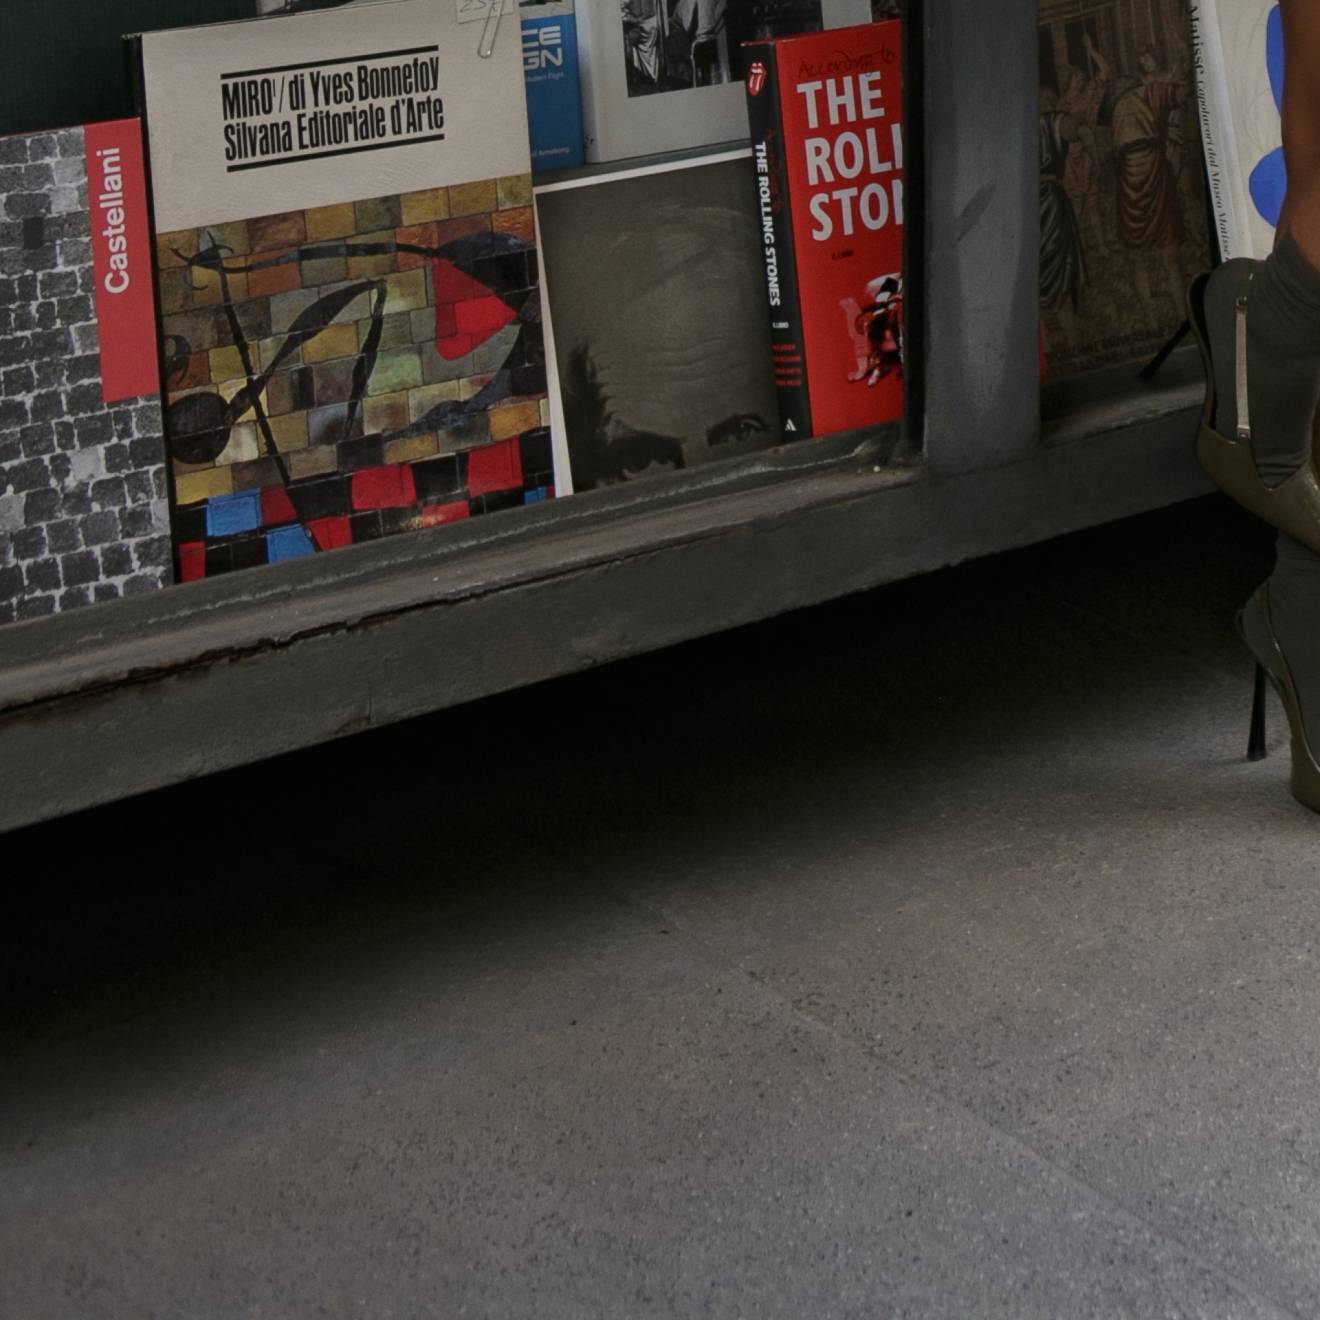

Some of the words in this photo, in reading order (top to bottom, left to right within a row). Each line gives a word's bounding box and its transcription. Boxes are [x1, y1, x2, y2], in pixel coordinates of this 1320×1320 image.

[221, 77, 276, 121] MIRO'
[288, 73, 306, 111] di
[309, 71, 354, 108] Yves
[357, 56, 439, 101] Bonnefoy
[796, 71, 886, 129] THE
[224, 120, 293, 162] Silvana
[297, 102, 386, 150] Editoriale
[390, 96, 444, 136] d'Arte
[754, 141, 769, 173] THE
[99, 146, 123, 294] Castellani
[757, 176, 775, 244] ROLLING
[764, 247, 781, 307] STONES
